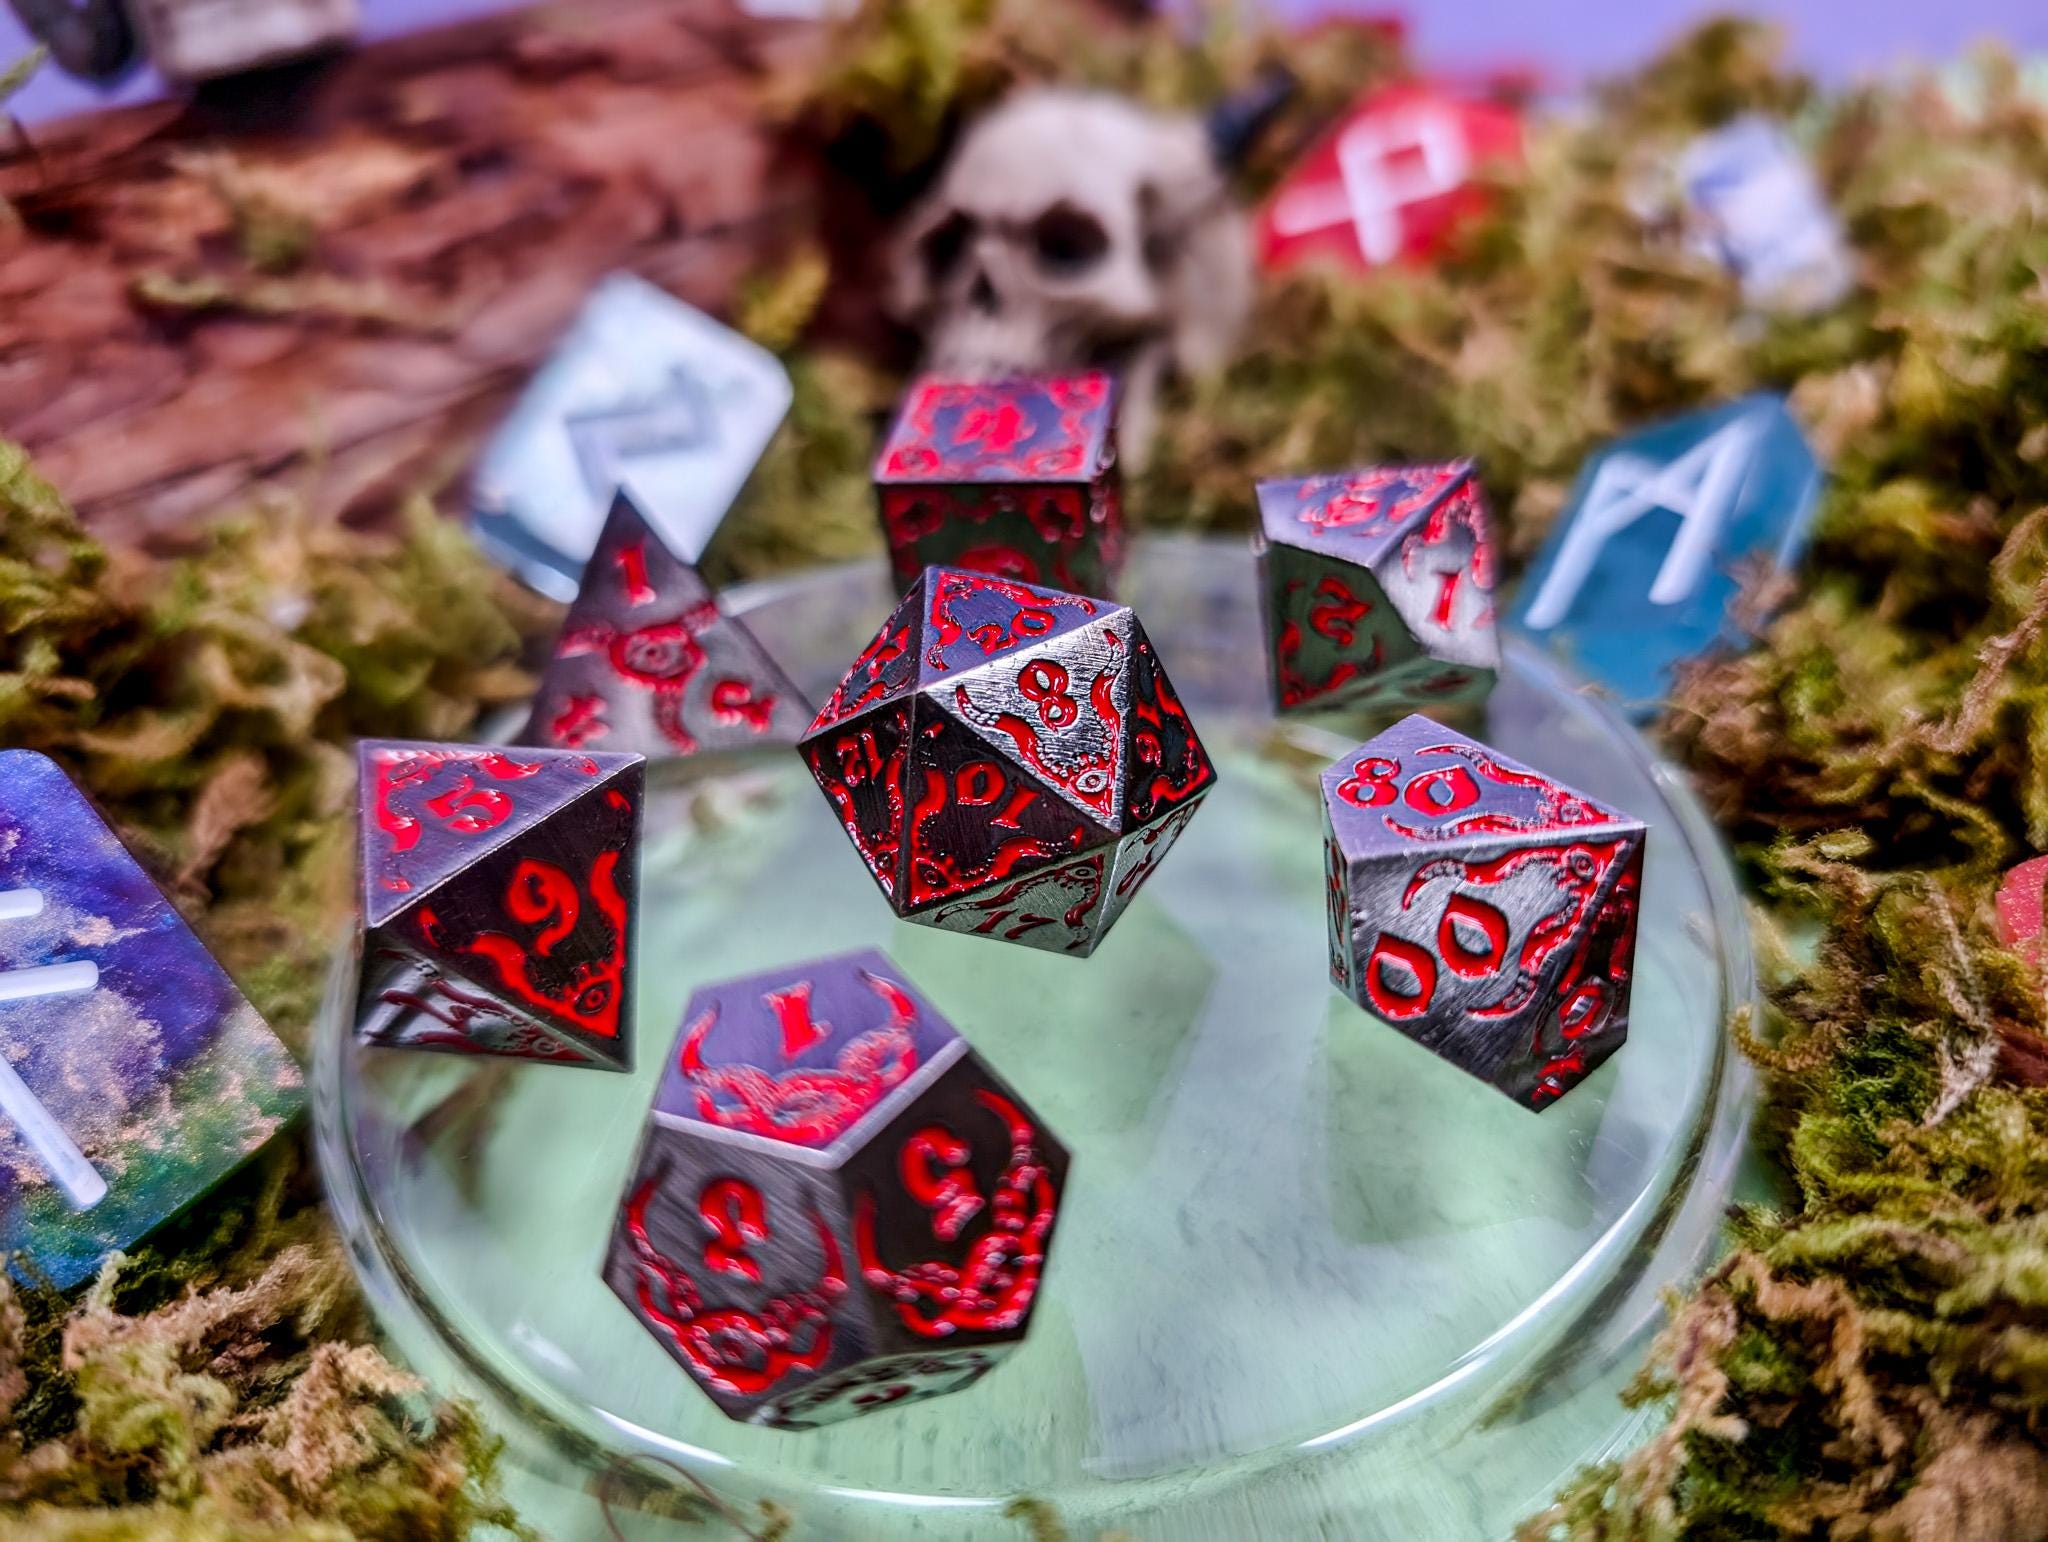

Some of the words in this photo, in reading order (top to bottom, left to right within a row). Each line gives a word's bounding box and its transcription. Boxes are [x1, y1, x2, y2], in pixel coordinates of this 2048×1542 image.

[614, 541, 656, 606] 1
[966, 606, 1056, 656] 20
[1018, 659, 1078, 732] 8
[426, 774, 513, 834] 5
[954, 760, 1042, 830] 10
[1336, 756, 1481, 818] 80
[1365, 892, 1509, 1020] 00
[763, 980, 832, 1062] 1
